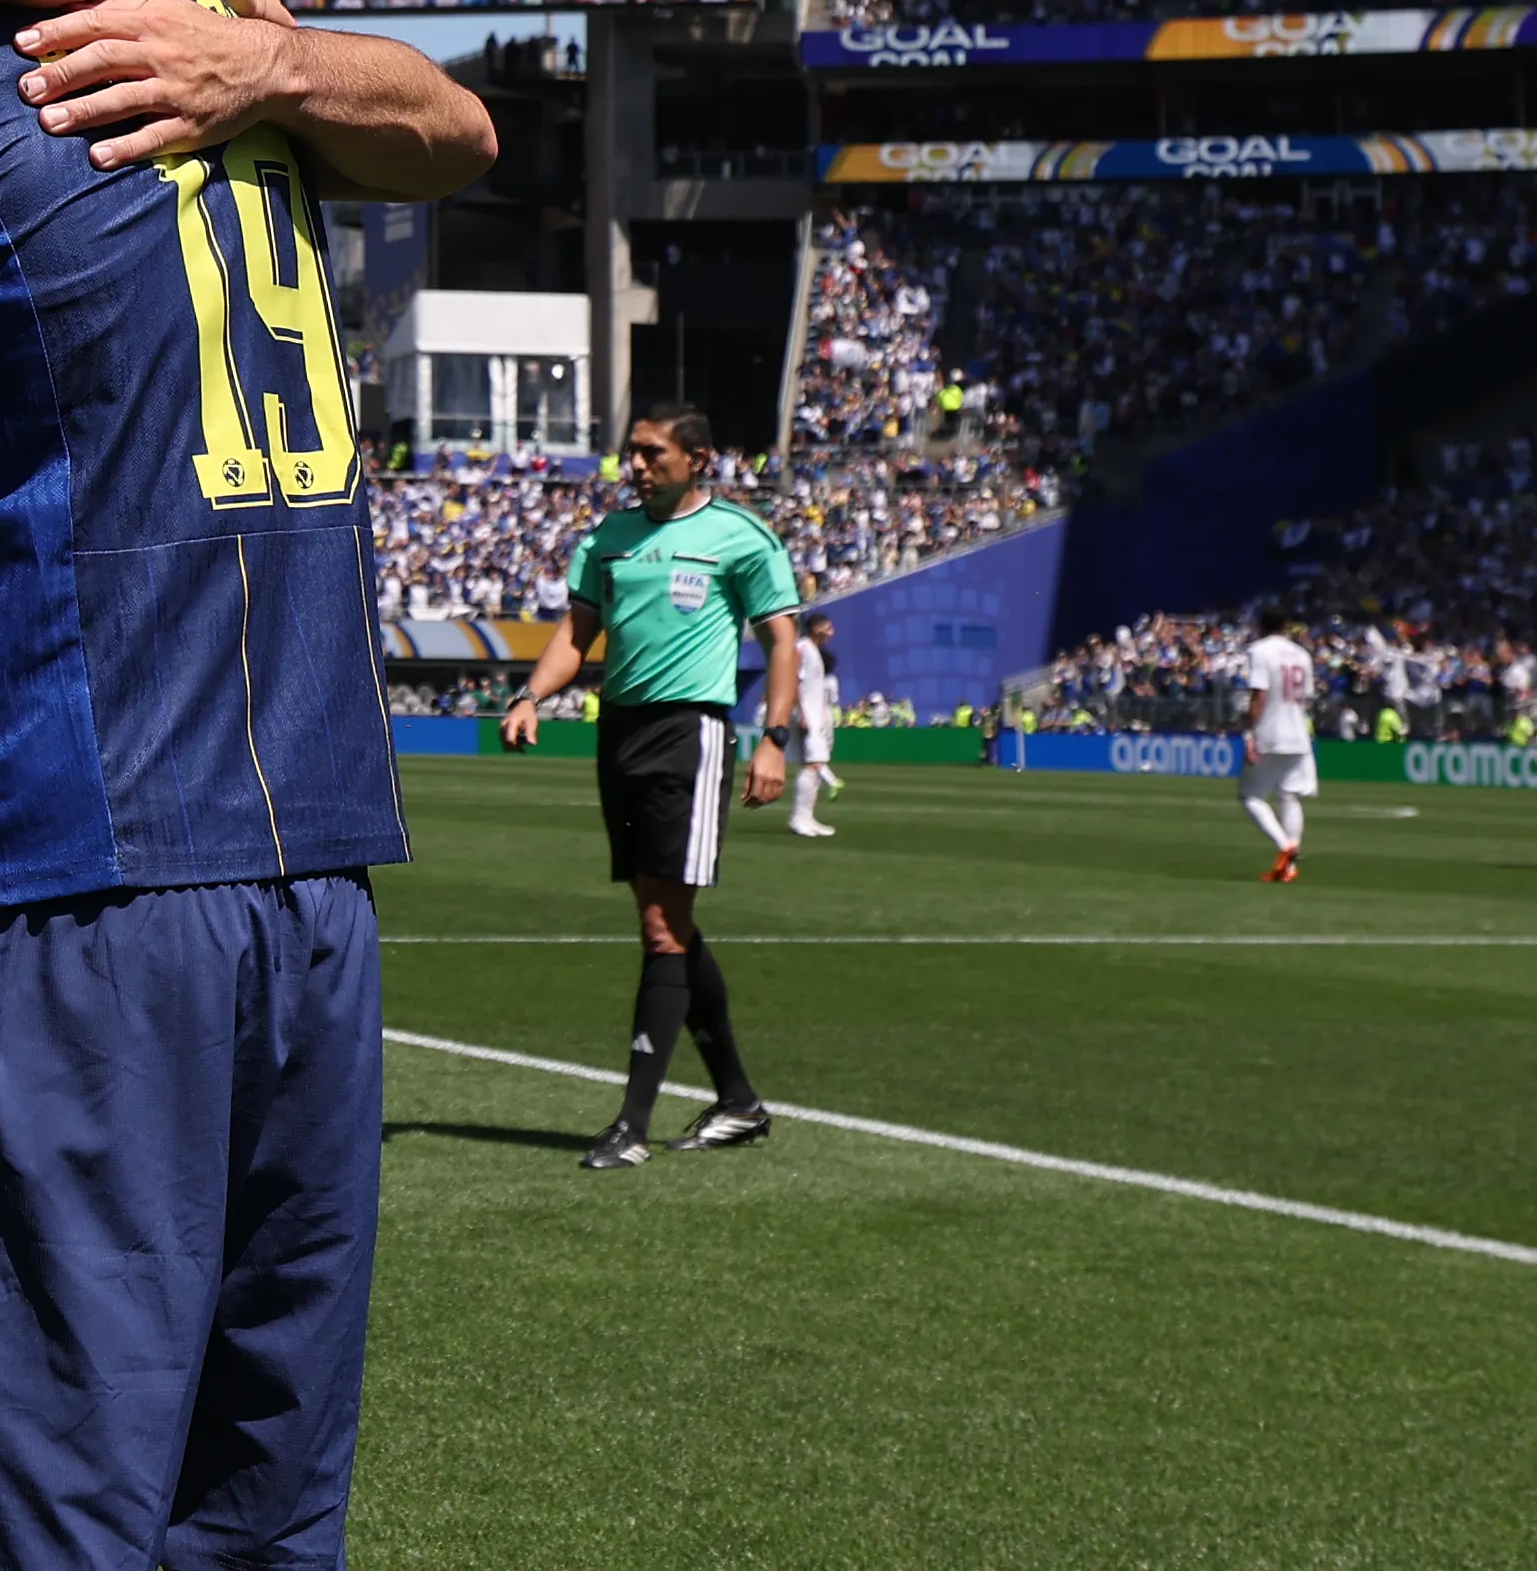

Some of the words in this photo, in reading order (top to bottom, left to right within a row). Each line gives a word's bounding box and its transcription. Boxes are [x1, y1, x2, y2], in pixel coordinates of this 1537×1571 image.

[1155, 134, 1312, 164] GOAL
[149, 120, 362, 511] 19
[675, 573, 705, 587] FIFA
[1110, 734, 1233, 776] aramco
